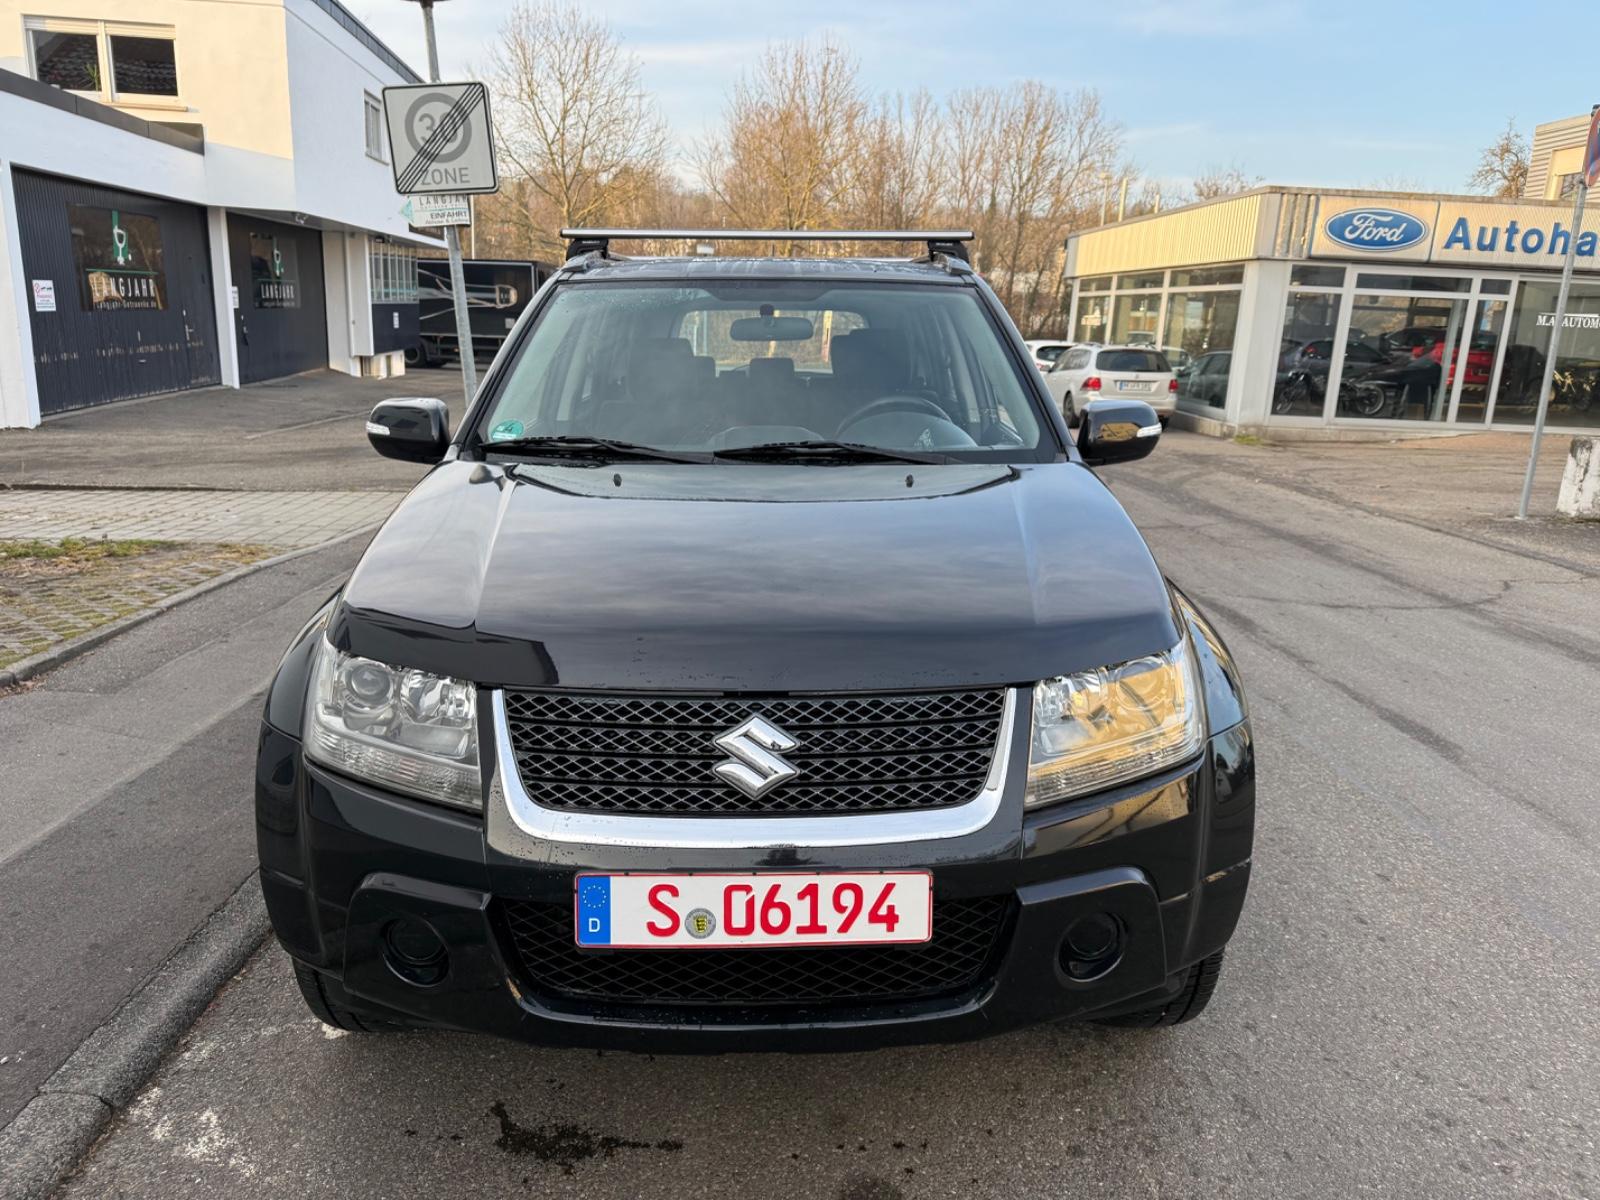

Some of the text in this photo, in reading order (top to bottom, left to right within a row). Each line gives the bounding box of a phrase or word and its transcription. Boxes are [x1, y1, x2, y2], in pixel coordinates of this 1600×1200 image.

[421, 167, 471, 185] ZONE
[430, 210, 468, 220] EINFAHRT
[1344, 212, 1408, 243] Ford
[93, 276, 156, 298] LANGJAHR
[1561, 316, 1600, 329] AUTOM
[646, 883, 681, 938] S
[723, 882, 900, 937] 06194
[588, 917, 601, 932] D
